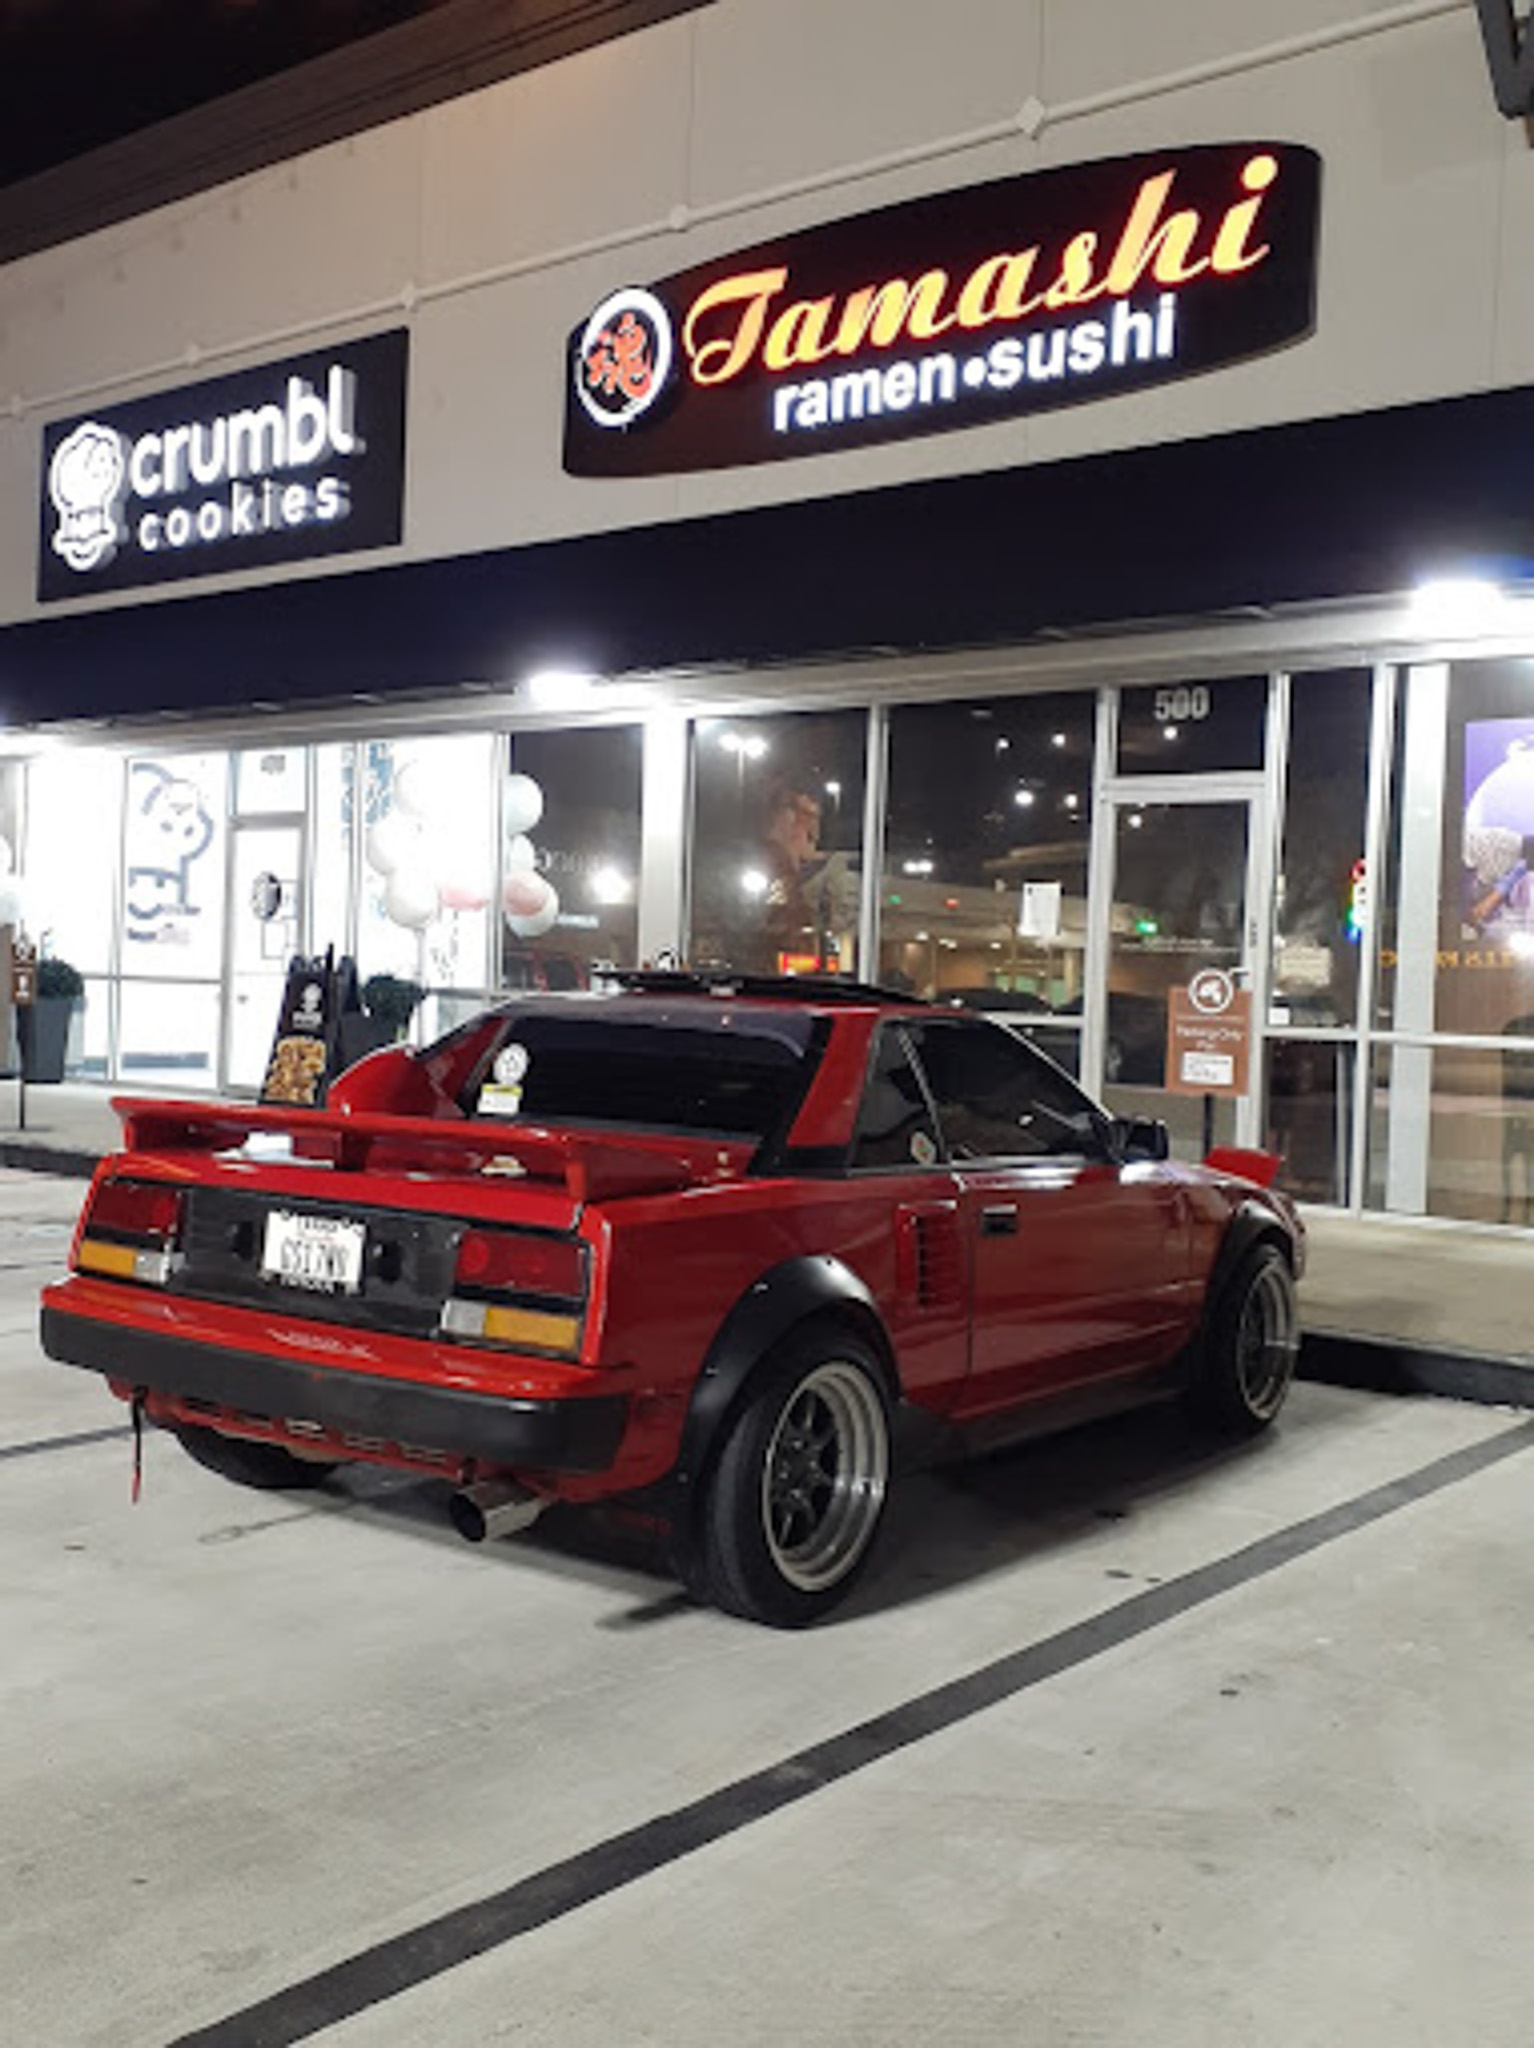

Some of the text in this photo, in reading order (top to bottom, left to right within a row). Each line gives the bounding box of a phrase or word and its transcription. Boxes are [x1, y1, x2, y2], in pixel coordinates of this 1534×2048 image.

[683, 155, 1277, 386] Tamashi
[130, 364, 360, 497] crumbl
[138, 476, 346, 551] cookies
[1153, 685, 1210, 721] 500
